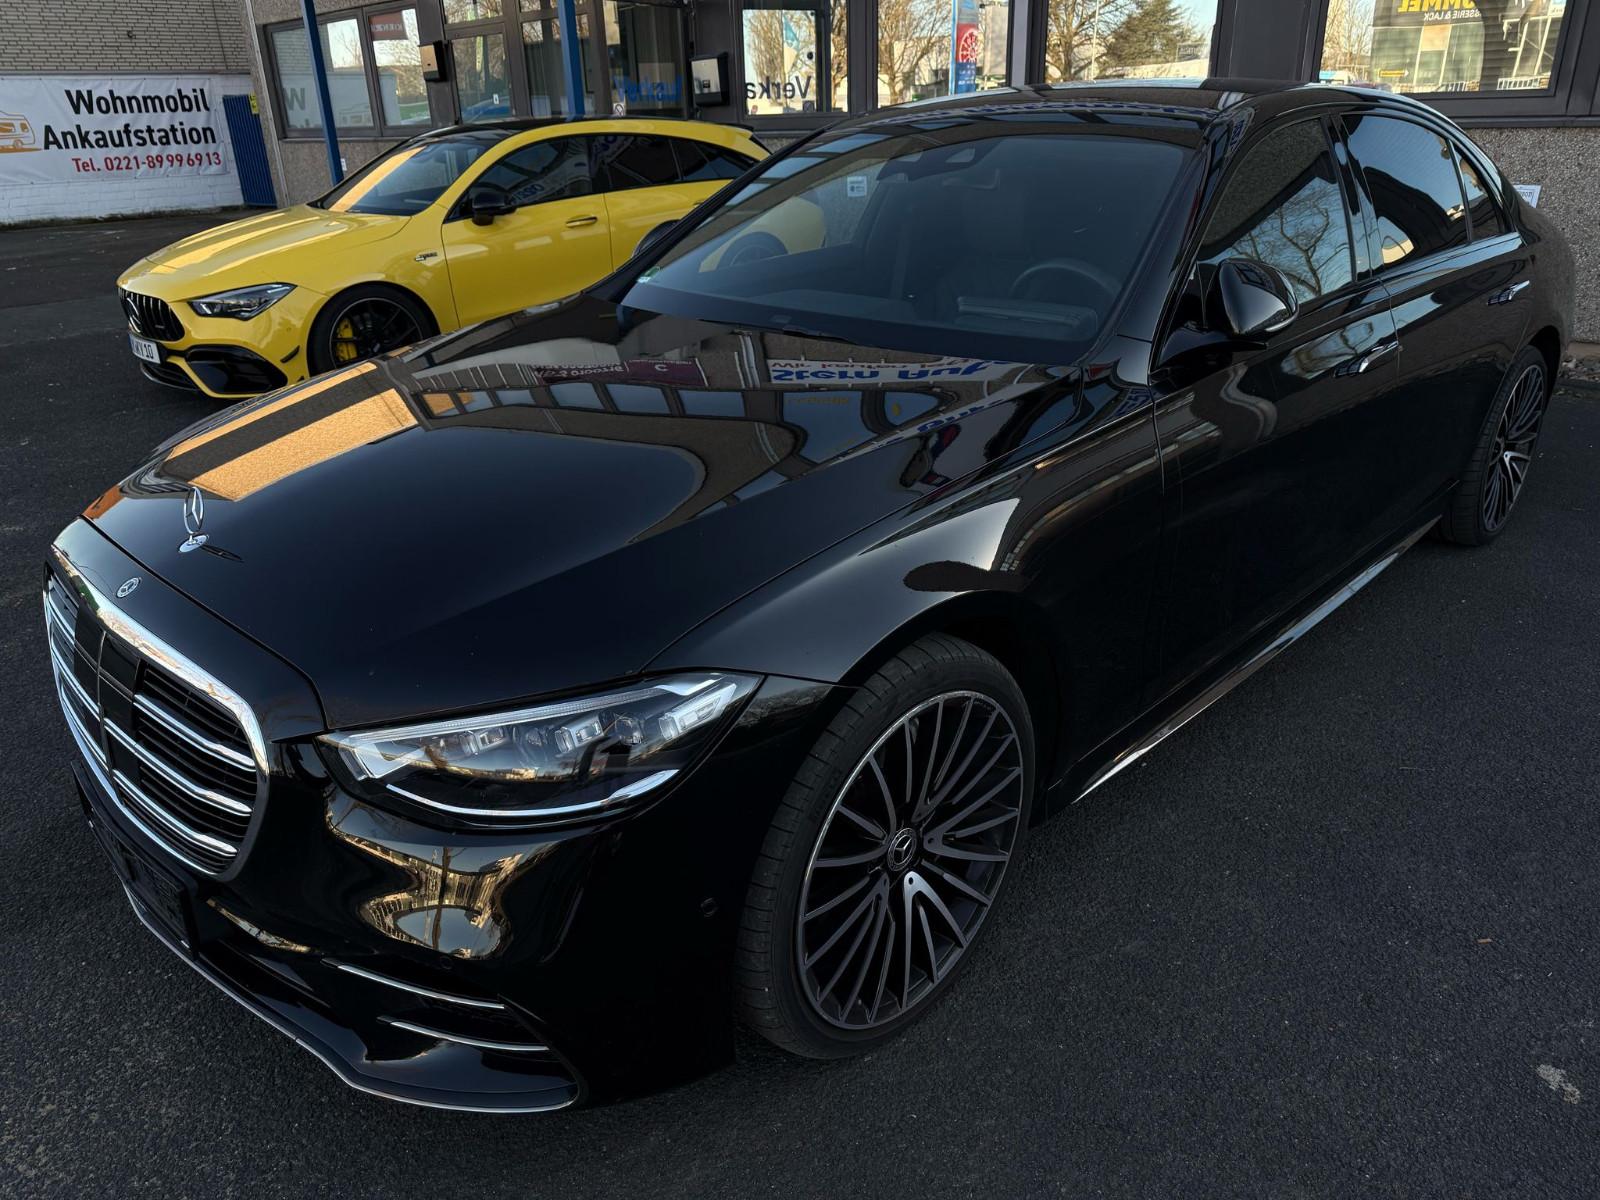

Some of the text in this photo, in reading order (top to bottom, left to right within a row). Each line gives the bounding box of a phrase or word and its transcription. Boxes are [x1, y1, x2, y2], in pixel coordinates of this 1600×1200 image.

[65, 88, 210, 115] Wohnmobil
[44, 122, 216, 150] Ankaufstation
[72, 157, 101, 172] Tel.
